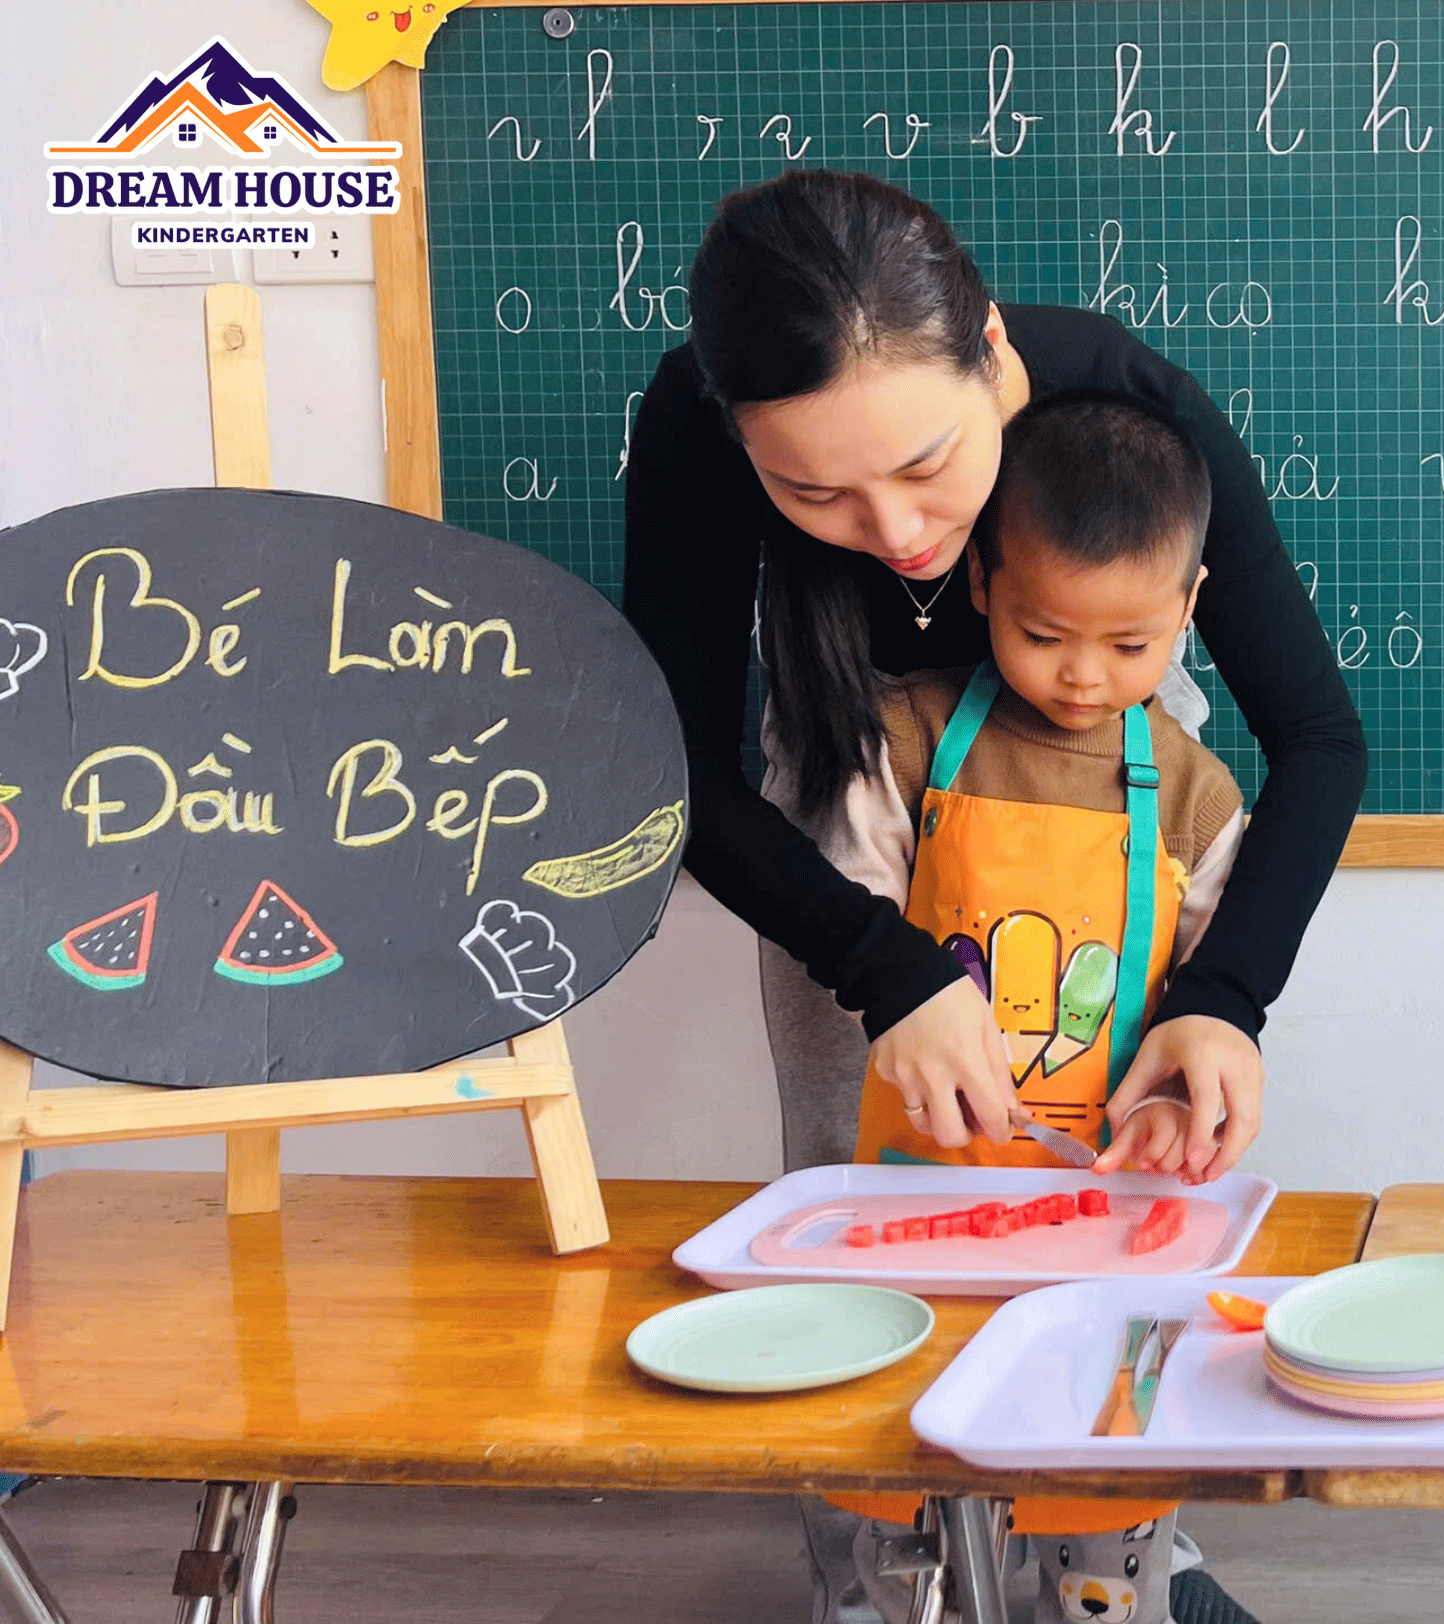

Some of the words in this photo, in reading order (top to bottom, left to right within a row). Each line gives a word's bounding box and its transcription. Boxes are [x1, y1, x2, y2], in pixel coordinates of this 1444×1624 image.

[982, 45, 1043, 158] b
[1108, 43, 1176, 156] k
[1257, 42, 1304, 155] l
[1363, 40, 1432, 154] h
[496, 286, 532, 334] o
[503, 457, 557, 500] a
[66, 547, 262, 688] Bé
[329, 559, 531, 677] Làm
[63, 733, 283, 847] Đầu
[327, 717, 547, 895] Bếp
